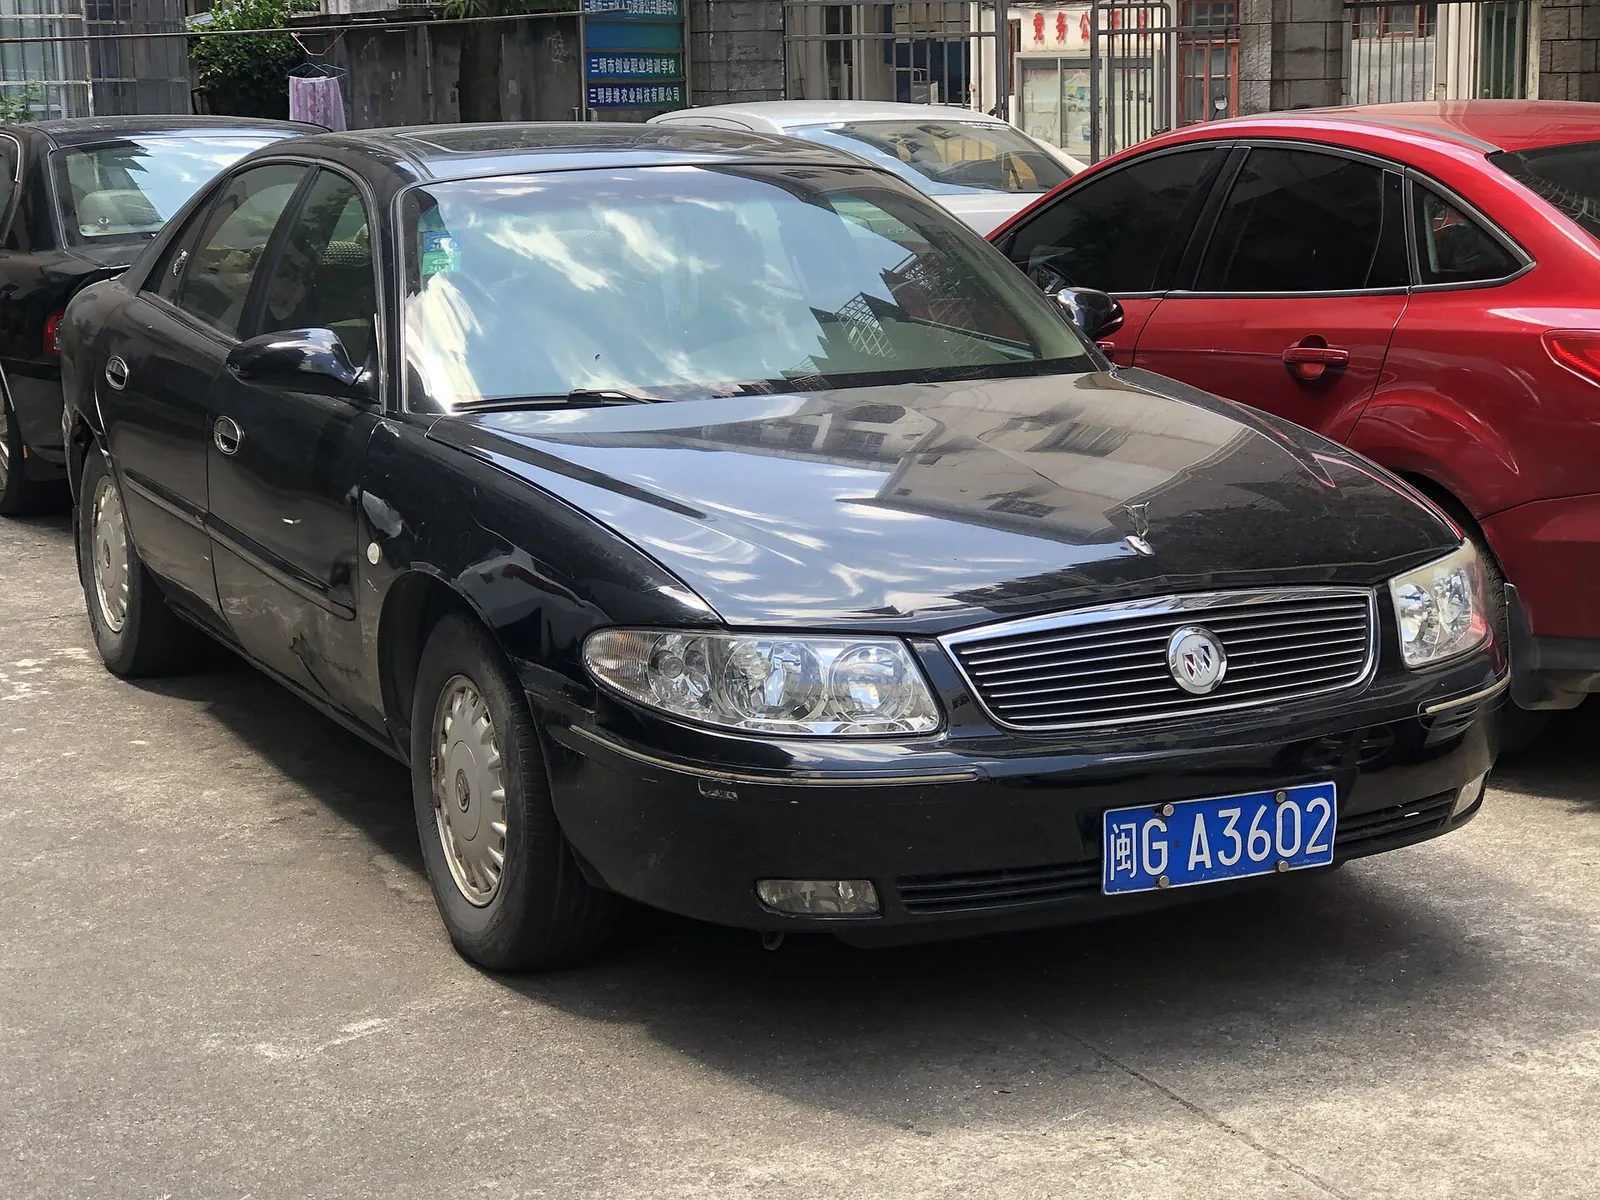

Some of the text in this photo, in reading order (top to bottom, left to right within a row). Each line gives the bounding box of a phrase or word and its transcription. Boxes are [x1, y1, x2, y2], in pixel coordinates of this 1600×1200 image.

[591, 57, 676, 74] 三明市创业职业培训学校
[429, 242, 458, 252] 209
[1187, 797, 1331, 871] A3602
